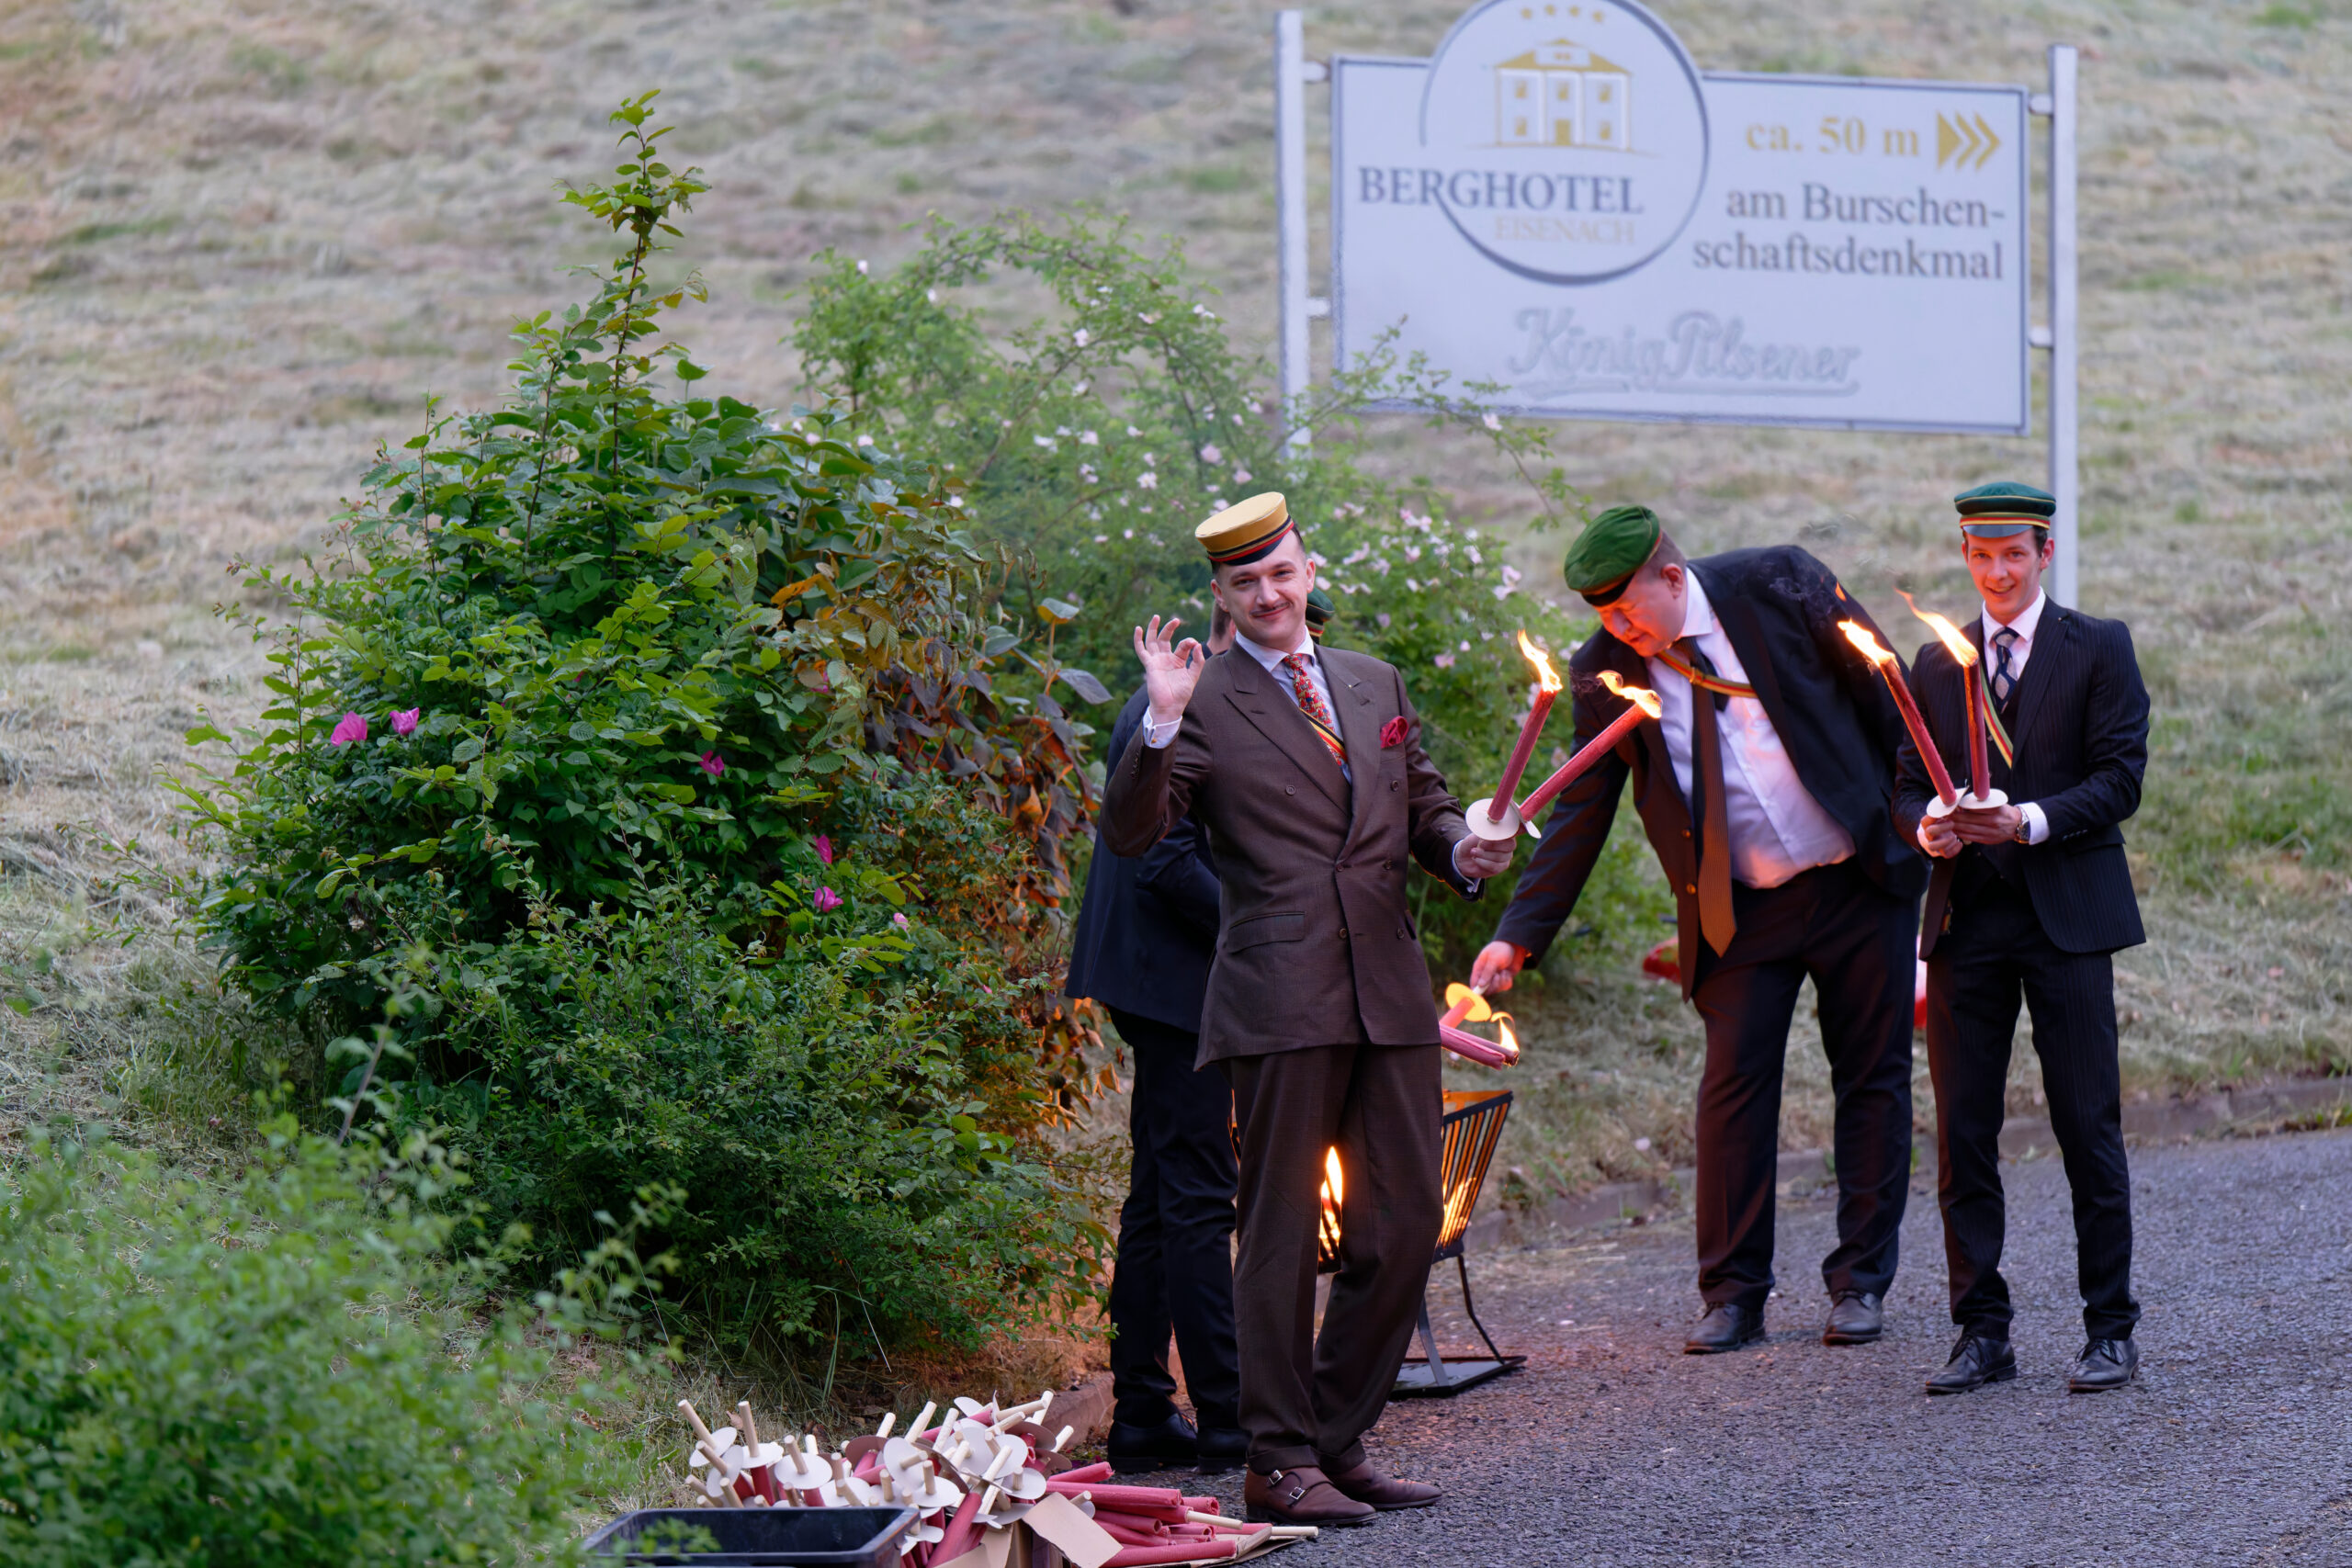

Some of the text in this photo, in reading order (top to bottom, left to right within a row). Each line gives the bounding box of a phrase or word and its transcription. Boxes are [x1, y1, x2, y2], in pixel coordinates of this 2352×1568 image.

[1746, 116, 1919, 157] ca. 50 m
[1358, 165, 1645, 214] BERGHOTEL
[1726, 182, 2006, 227] am Burschen-
[1494, 215, 1636, 244] EISENACH
[1692, 230, 2004, 280] schaftsdenkmal
[1667, 309, 1863, 384] Pilsener
